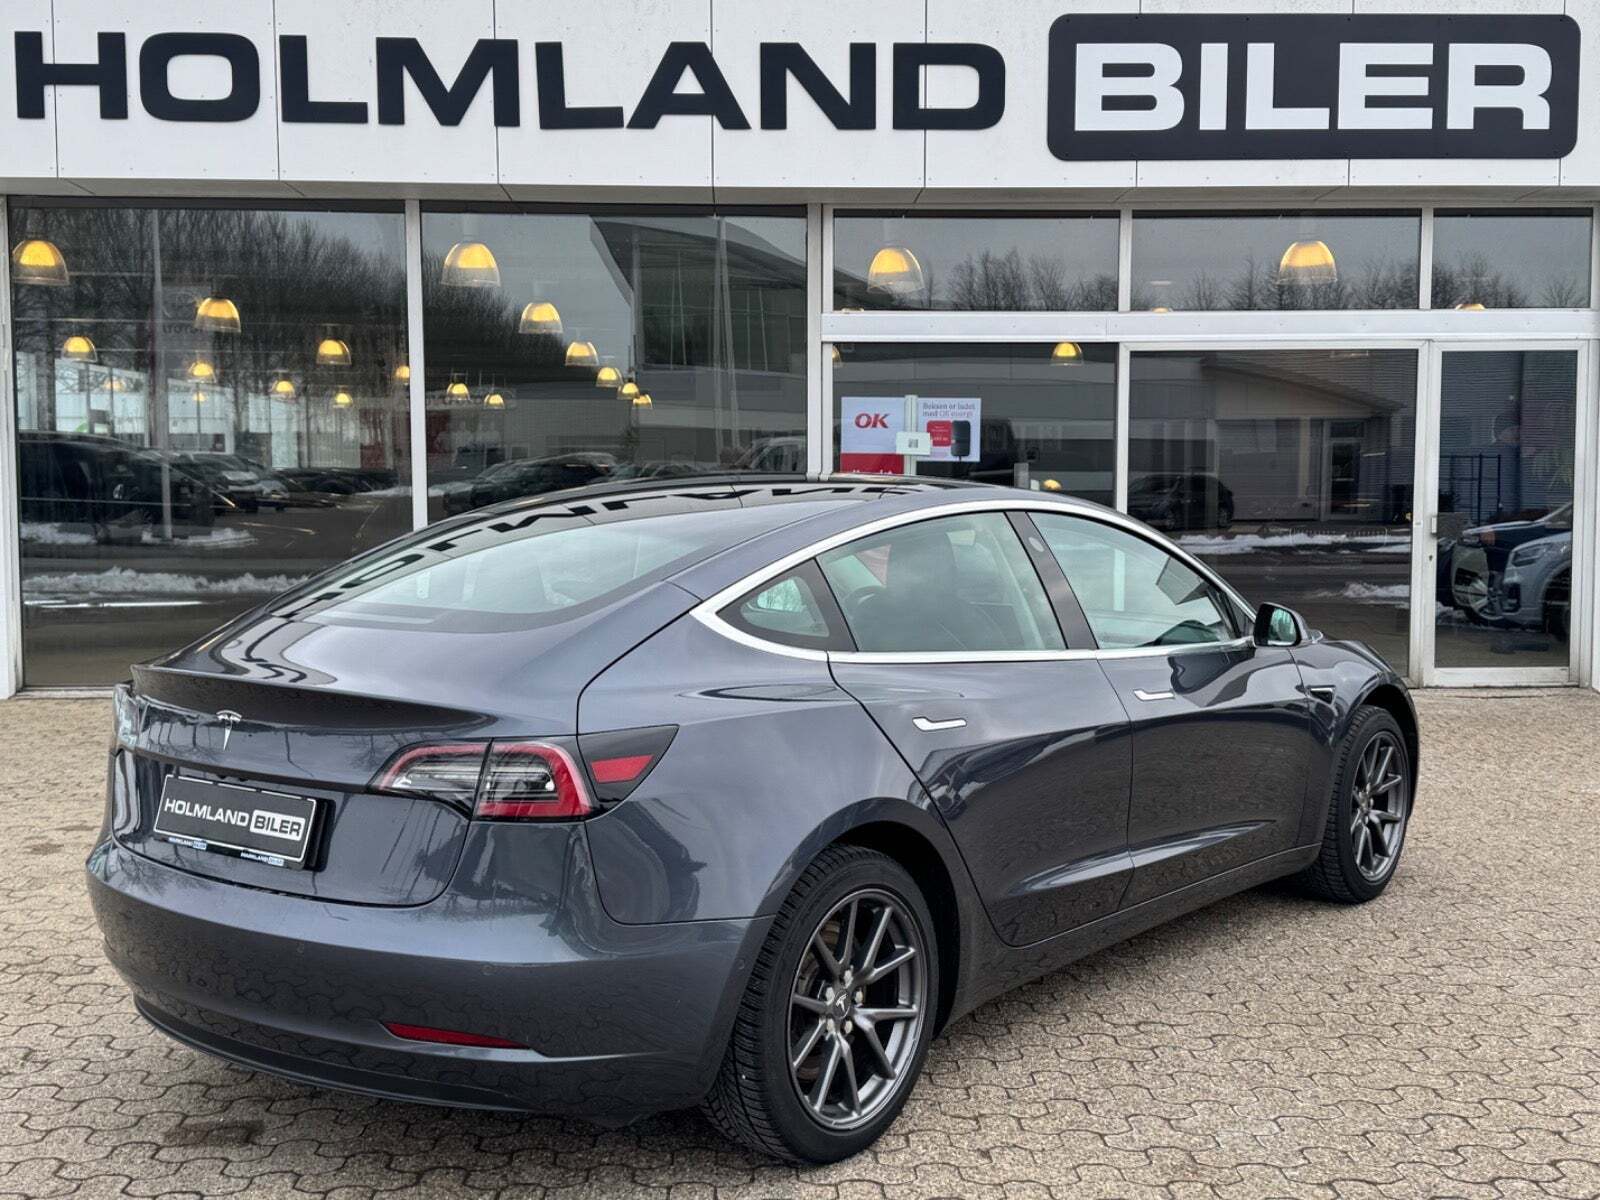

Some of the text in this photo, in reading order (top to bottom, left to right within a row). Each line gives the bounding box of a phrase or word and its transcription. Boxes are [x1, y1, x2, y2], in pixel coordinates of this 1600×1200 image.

[15, 31, 1552, 131] HOLMLAND BILER
[854, 412, 890, 429] OK
[164, 798, 302, 836] HOLMLAND BILER
